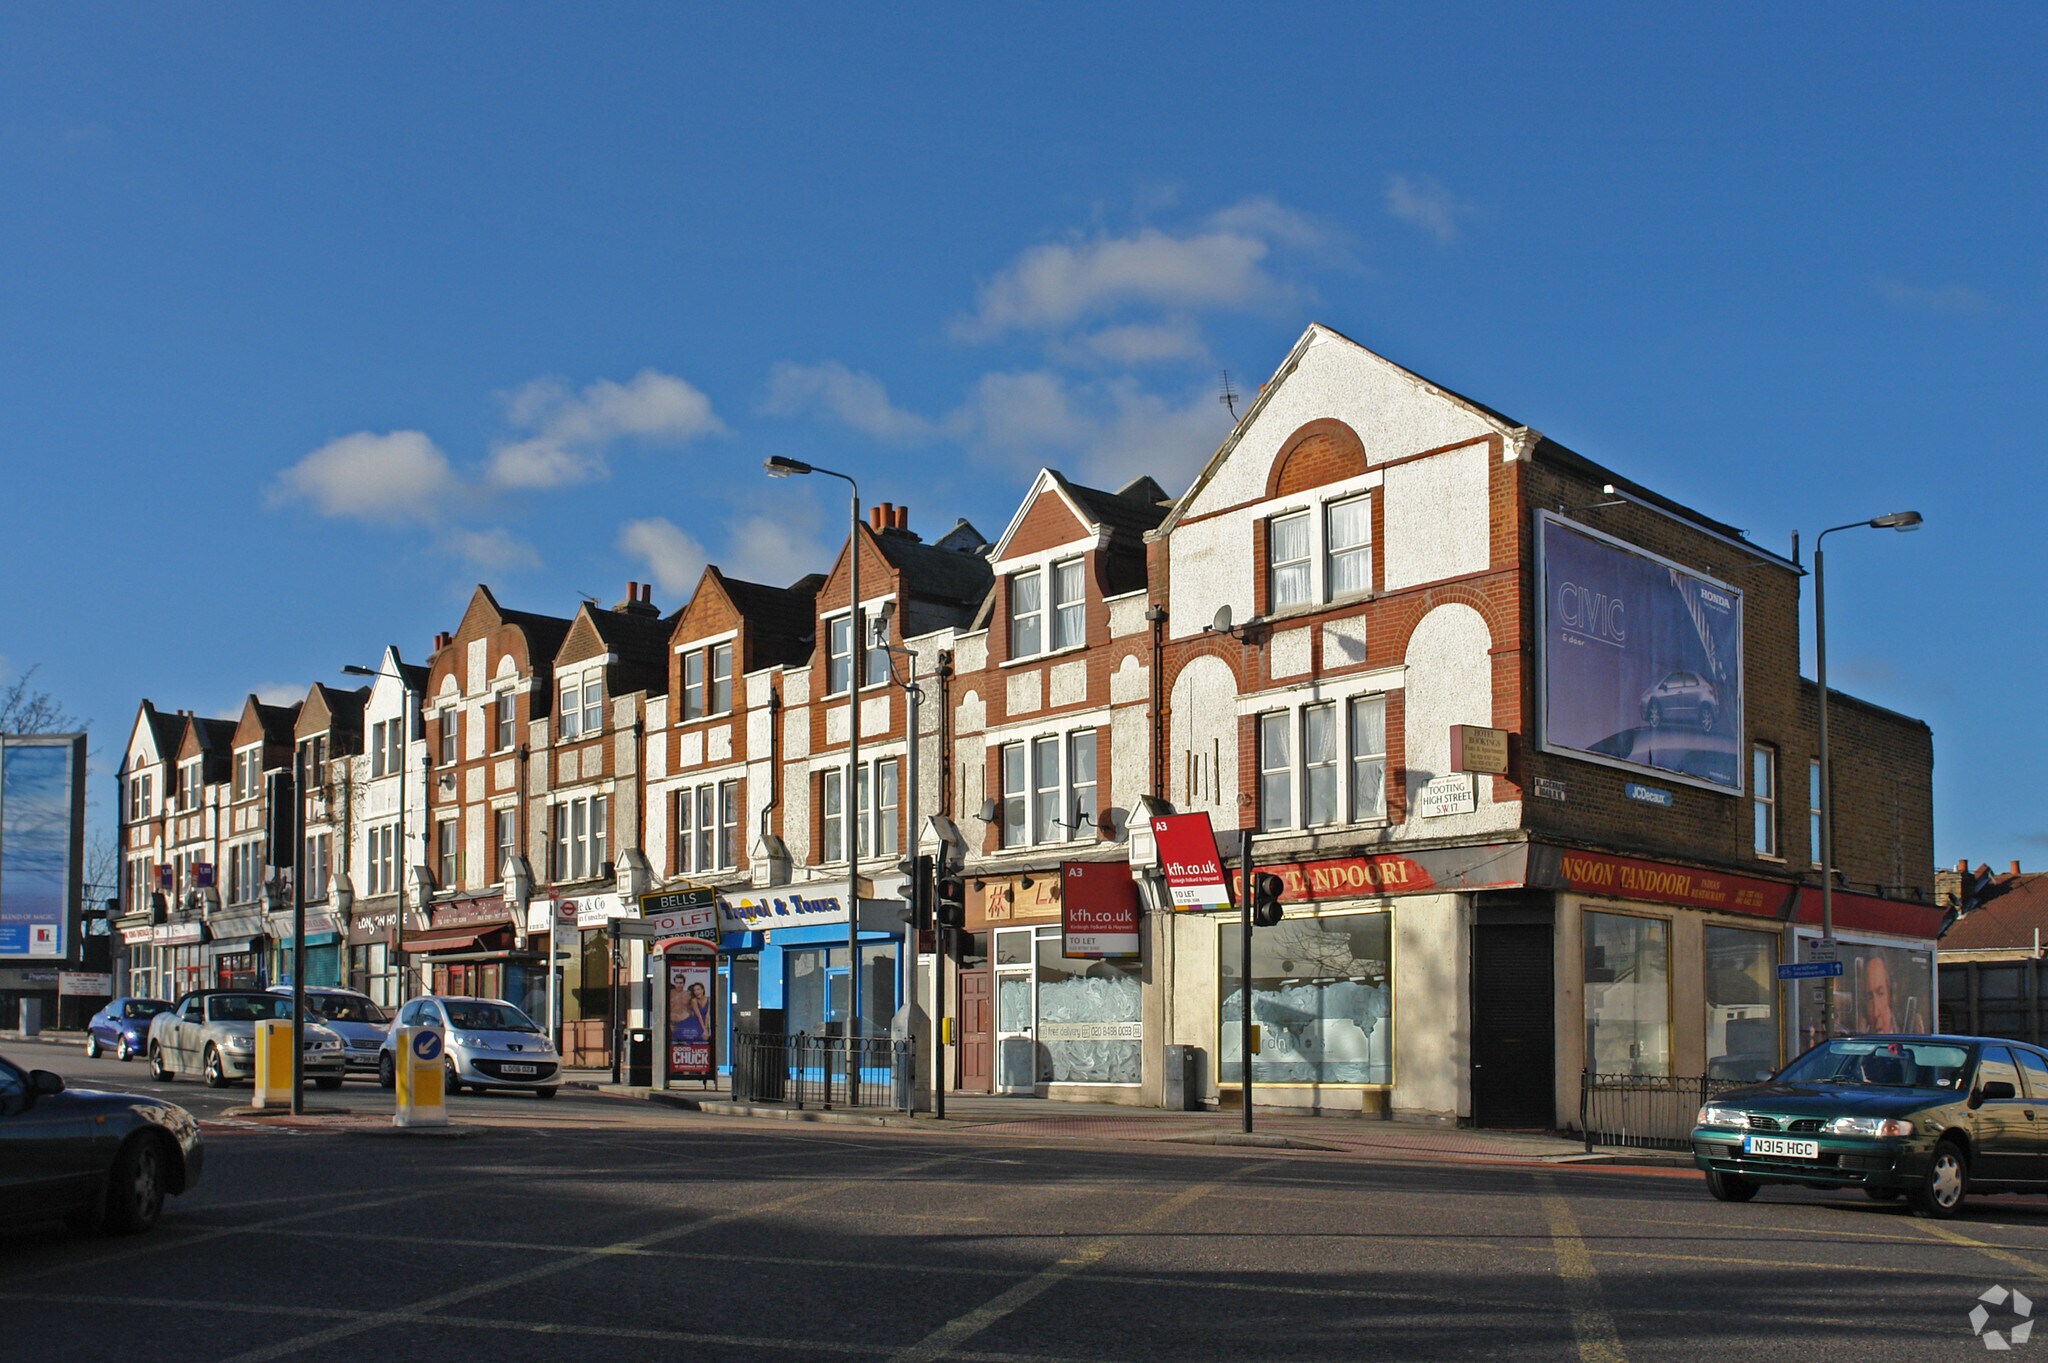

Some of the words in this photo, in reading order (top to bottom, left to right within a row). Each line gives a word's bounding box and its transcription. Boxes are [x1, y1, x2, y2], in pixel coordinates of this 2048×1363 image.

[1701, 588, 1730, 609] HONDA
[1559, 582, 1624, 641] CIVIC
[1568, 636, 1585, 647] door
[1473, 729, 1495, 738] HOTEL
[1468, 736, 1501, 747] BOOKINGS
[1429, 782, 1465, 795] TOOTING
[1632, 786, 1665, 804] JCDecaux
[1423, 795, 1442, 805] HIGH
[1156, 821, 1168, 832] A3
[1068, 867, 1083, 877] A3
[1166, 860, 1217, 876] kfh.co.uk
[1285, 861, 1408, 892] TANDOORI
[1620, 865, 1691, 897] TANDOORI
[661, 893, 697, 908] BELLS
[1175, 890, 1183, 898] TO
[1184, 890, 1195, 898] LET
[585, 898, 592, 911] &
[594, 896, 605, 910] Co
[774, 898, 790, 916] &
[789, 894, 841, 914] Tours
[653, 918, 675, 930] TO
[681, 911, 712, 926] LET
[1070, 909, 1132, 922] kfh.co.uk
[694, 929, 715, 939] 4405
[1070, 937, 1080, 945] TO
[1082, 937, 1096, 945] LET
[1047, 1026, 1058, 1036] free
[1060, 1025, 1081, 1038] delivery
[672, 1051, 709, 1065] CHUCK
[1754, 1140, 1783, 1154] N315
[1787, 1141, 1812, 1156] HGC
